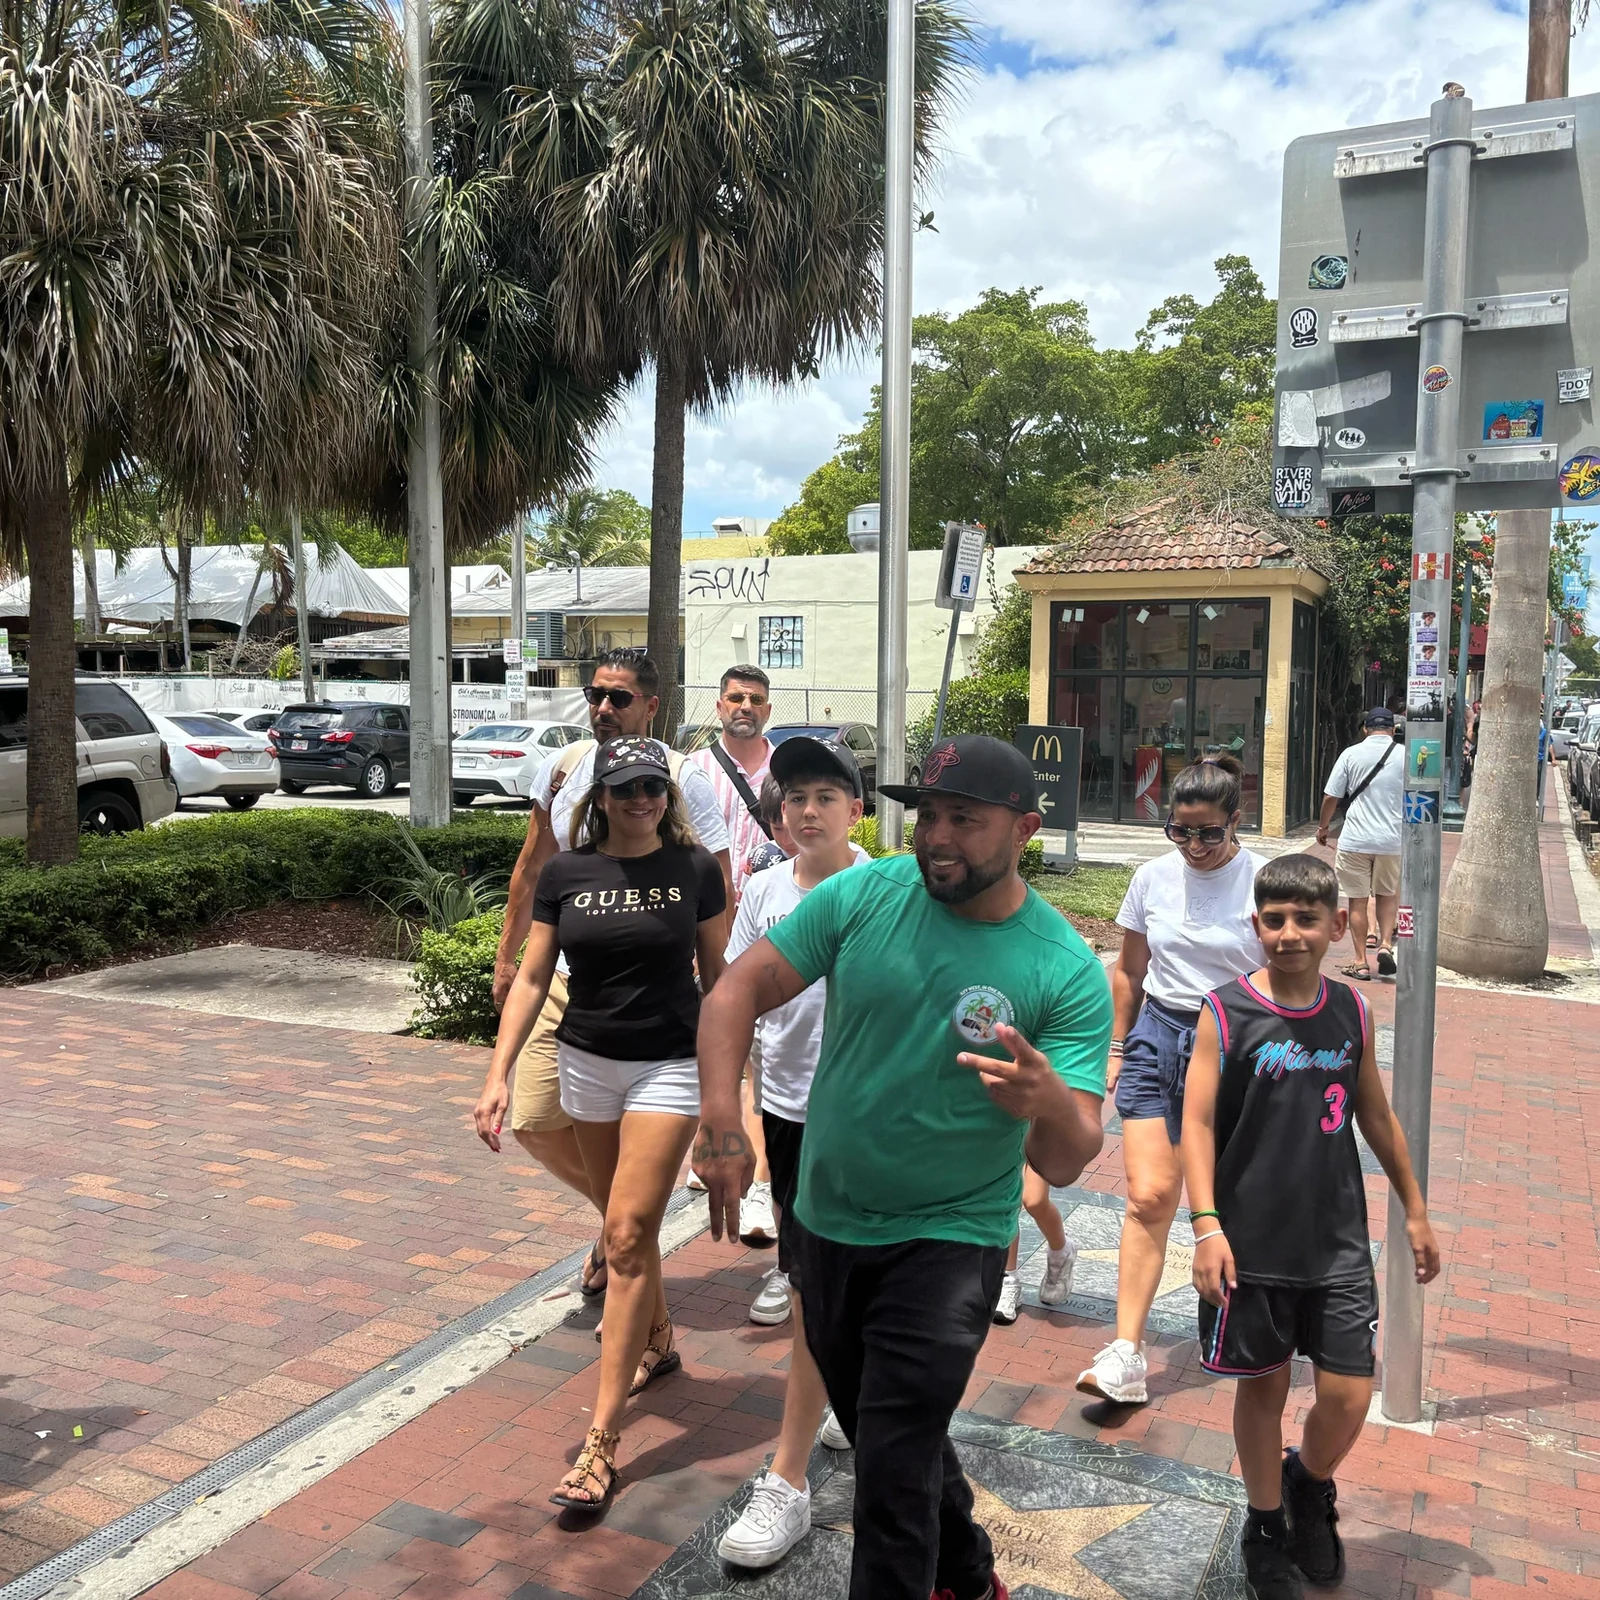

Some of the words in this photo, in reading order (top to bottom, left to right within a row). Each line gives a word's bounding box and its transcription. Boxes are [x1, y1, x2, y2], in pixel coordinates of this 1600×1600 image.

[1560, 378, 1590, 391] FDOT
[1276, 467, 1312, 479] RIVER
[1275, 479, 1312, 491] SANG
[1274, 491, 1311, 505] WILD
[1033, 770, 1061, 782] Enter
[574, 887, 682, 908] GUESS
[586, 908, 606, 916] LOS
[614, 903, 666, 914] ANGELES
[1249, 1040, 1353, 1081] Miami
[1320, 1083, 1347, 1134] 3
